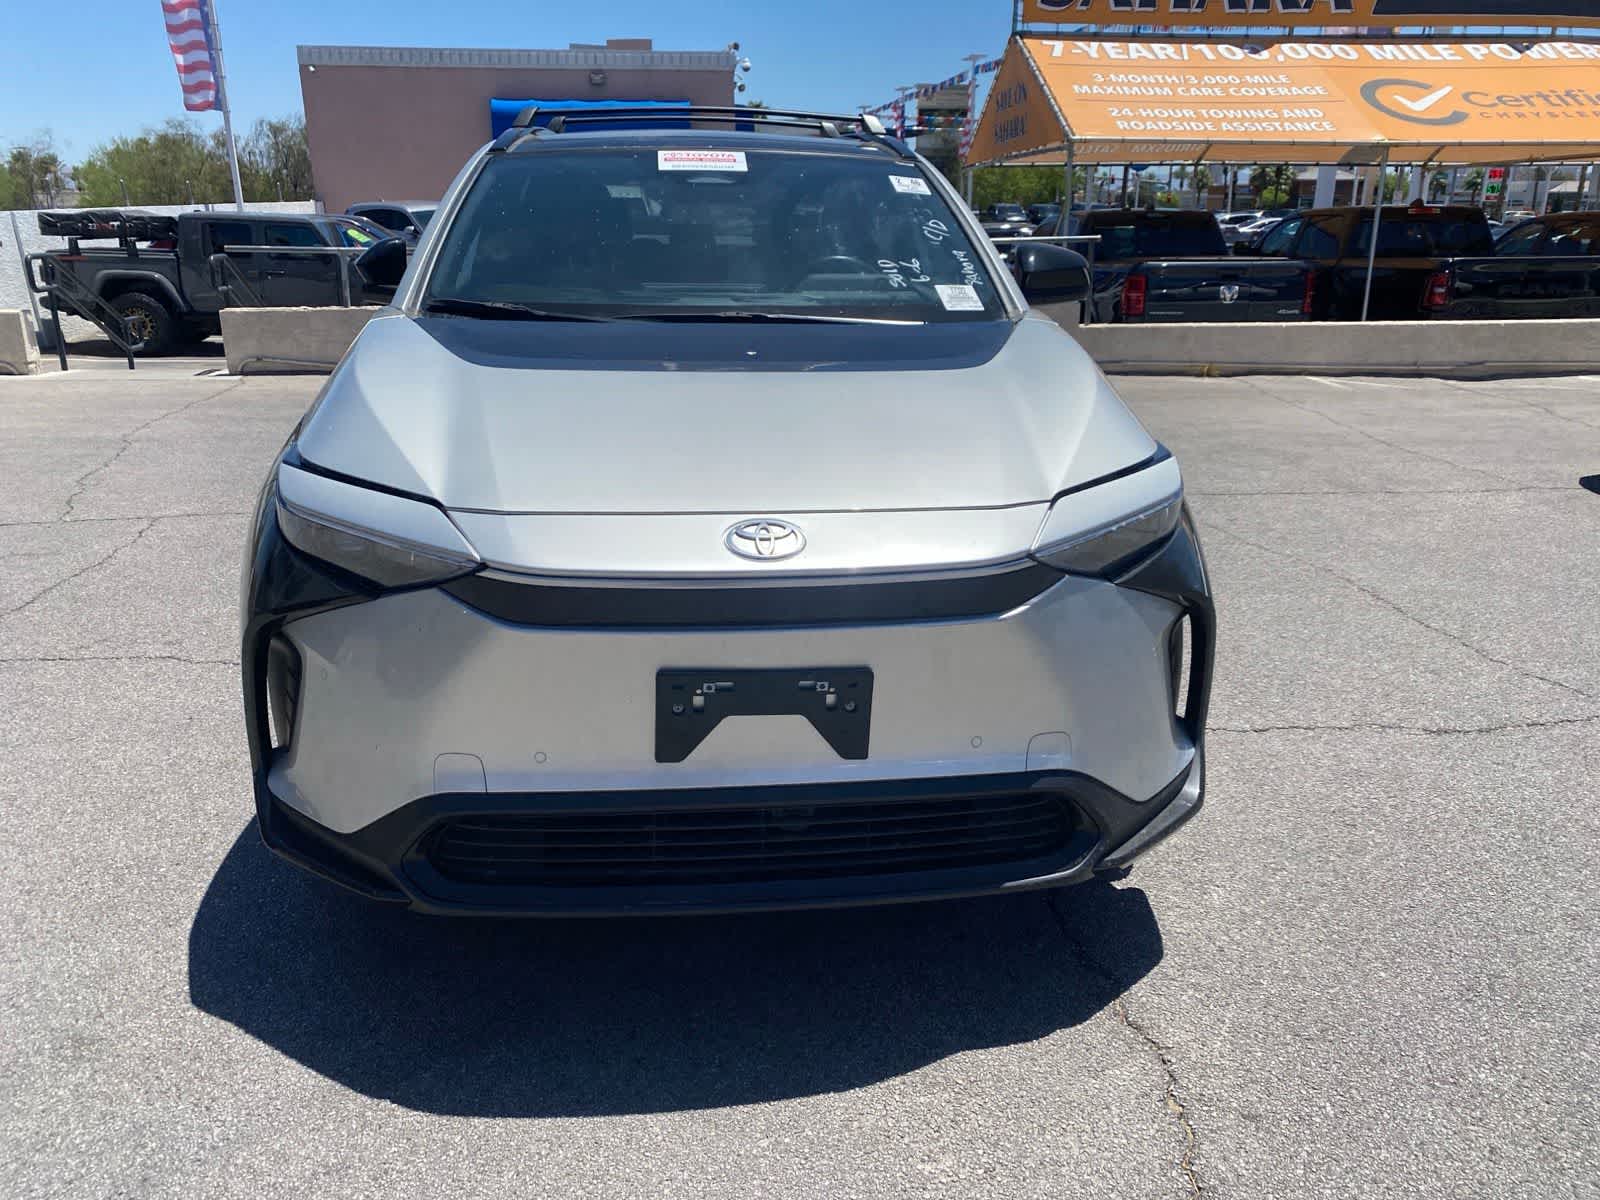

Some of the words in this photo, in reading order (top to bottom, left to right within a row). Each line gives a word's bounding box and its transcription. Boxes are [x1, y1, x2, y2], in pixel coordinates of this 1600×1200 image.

[1363, 44, 1463, 60] MILE
[1072, 84, 1172, 96] MAXIMUM
[1176, 87, 1225, 96] CARE
[1229, 86, 1328, 96] COVERAGE
[1461, 89, 1600, 107] Certifi
[1107, 107, 1196, 118] 24-HOUR
[1197, 108, 1279, 118] TOWING
[1281, 107, 1324, 118] AND
[1117, 120, 1217, 131] ROADSIDE
[1221, 120, 1337, 132] ASSISTANCE
